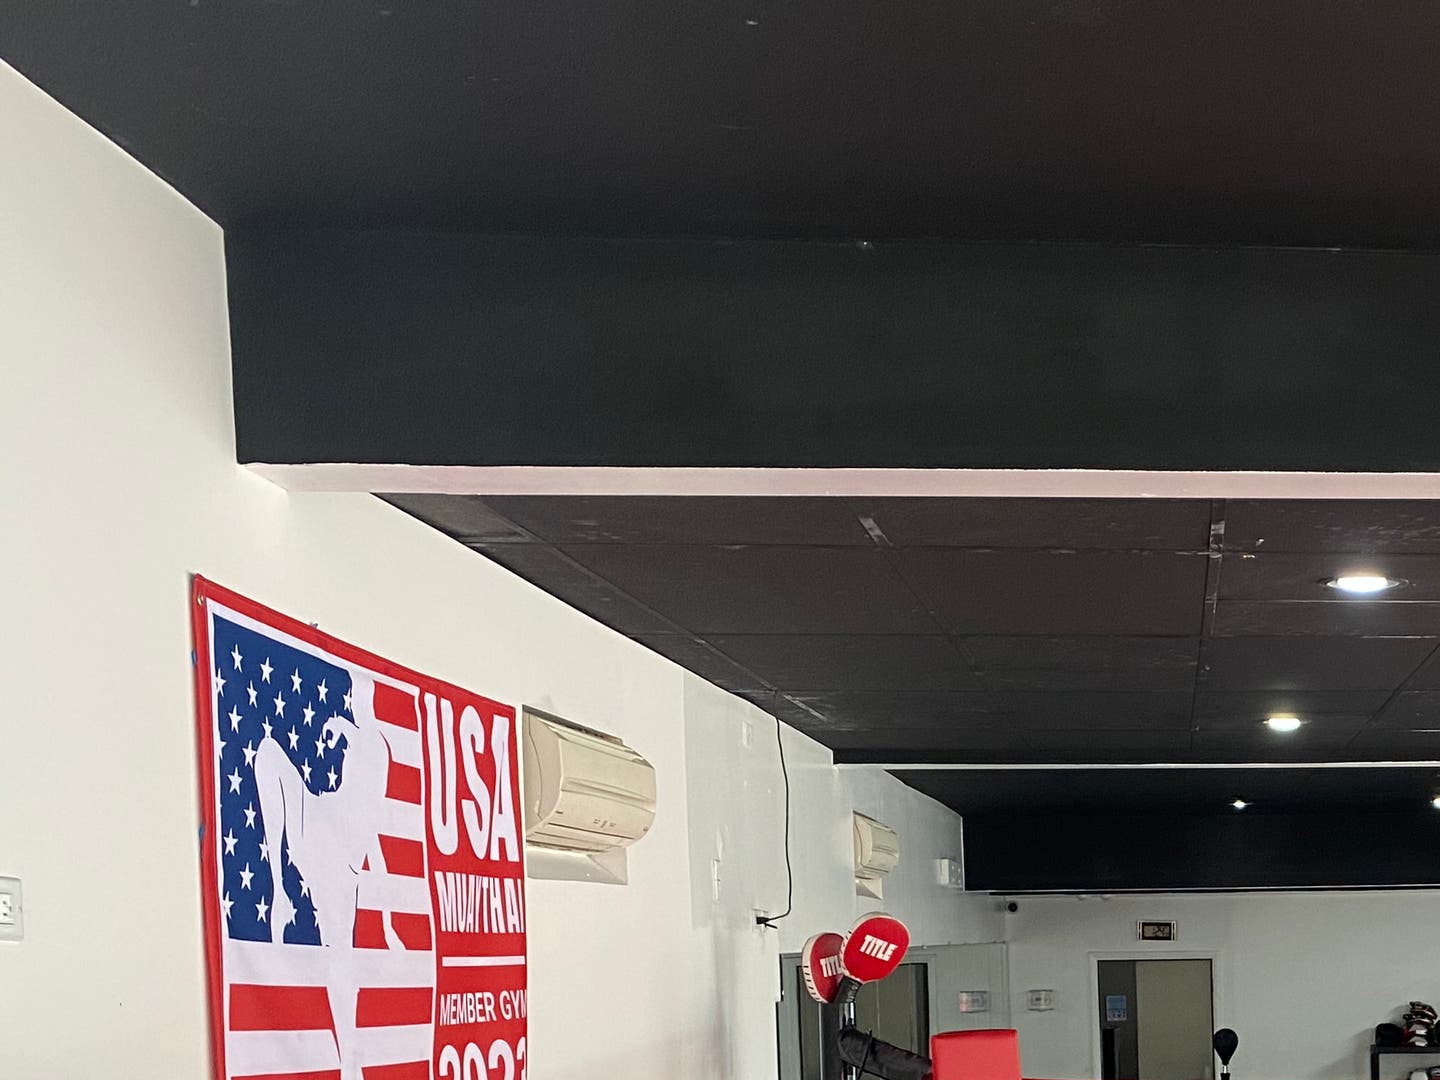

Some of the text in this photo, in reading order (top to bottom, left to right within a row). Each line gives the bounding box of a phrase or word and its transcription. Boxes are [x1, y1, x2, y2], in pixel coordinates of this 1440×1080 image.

[424, 692, 520, 862] USA
[859, 934, 899, 962] TITLE
[820, 954, 845, 978] TITL
[440, 991, 497, 1027] MEMBER
